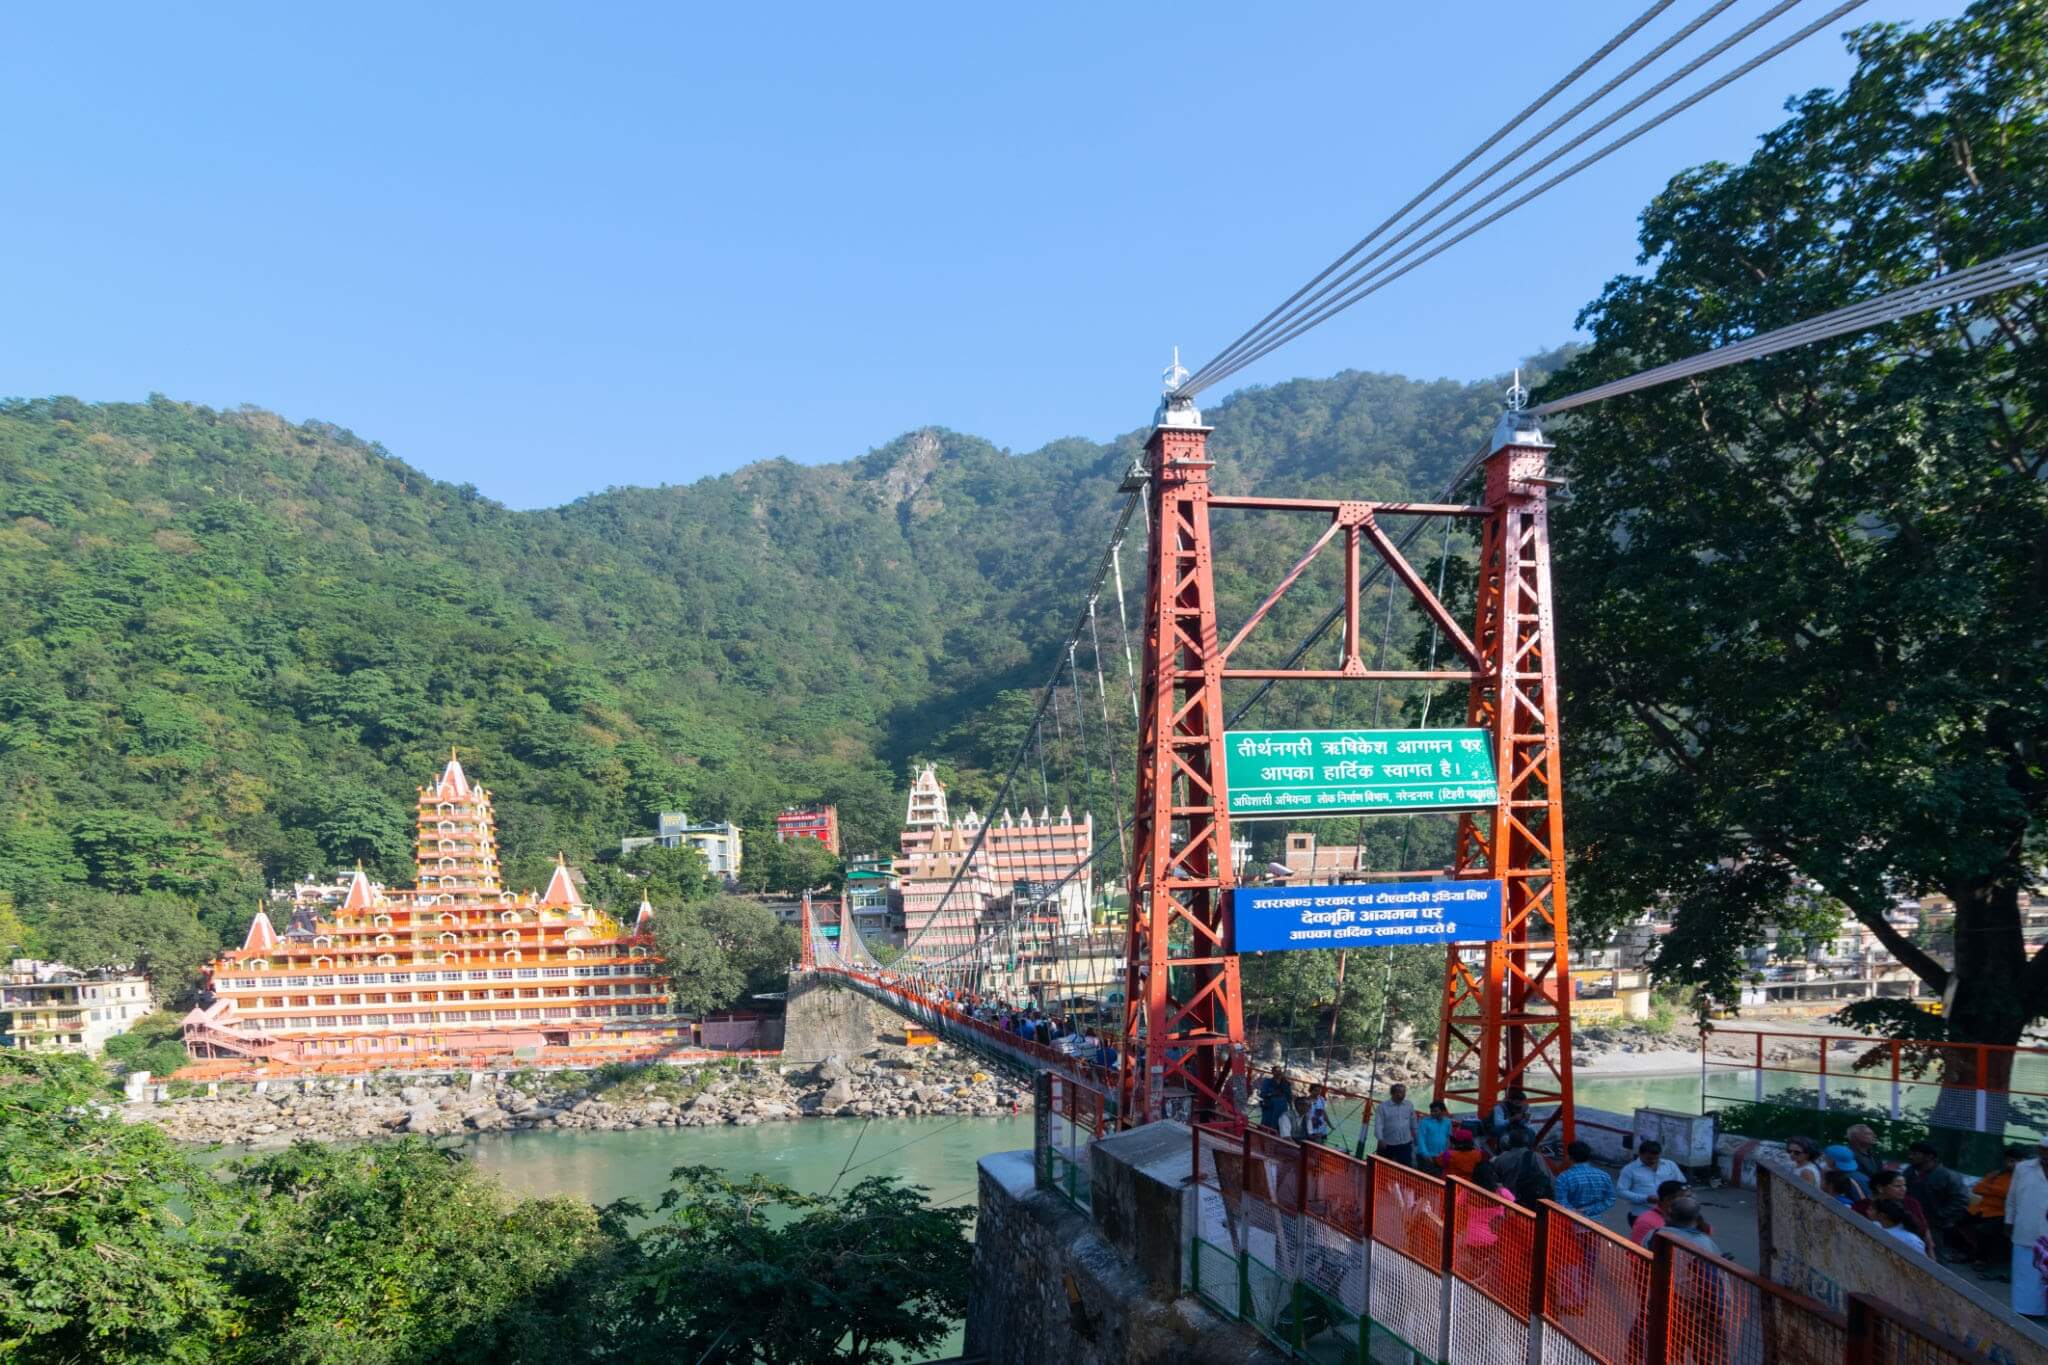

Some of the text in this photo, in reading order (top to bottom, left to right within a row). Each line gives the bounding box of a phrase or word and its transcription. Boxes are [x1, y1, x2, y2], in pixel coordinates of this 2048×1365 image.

[1237, 737, 1482, 758] तीर्थनगरी ऋषिकेश आगमन पर
[1261, 759, 1460, 780] आपका हार्दिक स्वागत है।
[1234, 794, 1272, 806] अधिशासी
[1318, 792, 1336, 803] लोक
[1253, 898, 1312, 909] उत्तराखण्ड
[1315, 897, 1355, 906] सरकार
[1301, 908, 1443, 925] देवभूमि आगमन पर
[1290, 930, 1331, 939] आपका
[1333, 926, 1373, 938] हार्दिक
[1375, 926, 1413, 936] स्वागत
[1415, 922, 1445, 933] करते
